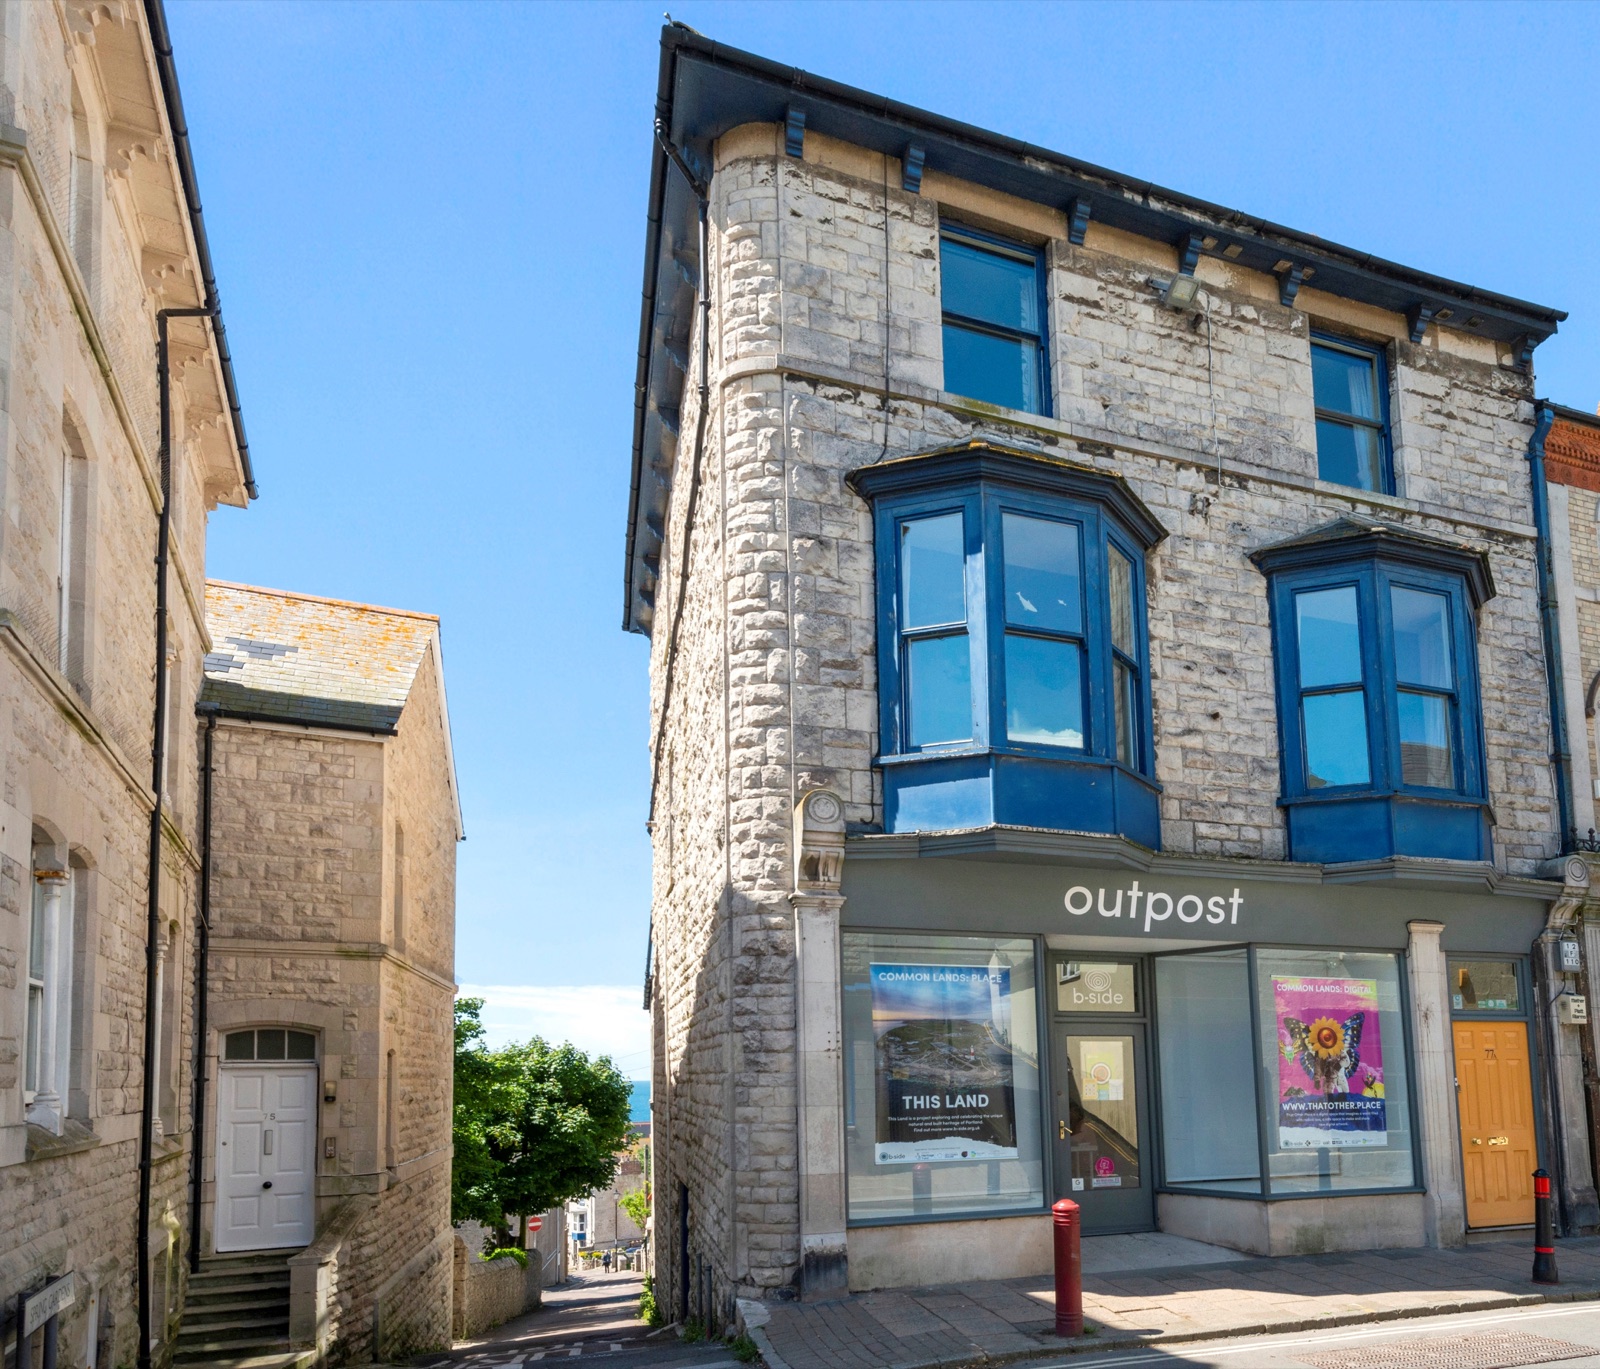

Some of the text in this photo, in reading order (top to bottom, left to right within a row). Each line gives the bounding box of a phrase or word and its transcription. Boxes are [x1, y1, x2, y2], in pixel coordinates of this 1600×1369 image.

[1064, 881, 1243, 932] outpost
[878, 972, 1002, 983] COMMON LANDS: PLACE
[1073, 988, 1123, 1004] b-side
[902, 1094, 989, 1109] THIS LAND
[1282, 1102, 1381, 1110] WWW.THATOTHER.PLACE
[888, 1152, 906, 1160] b-side
